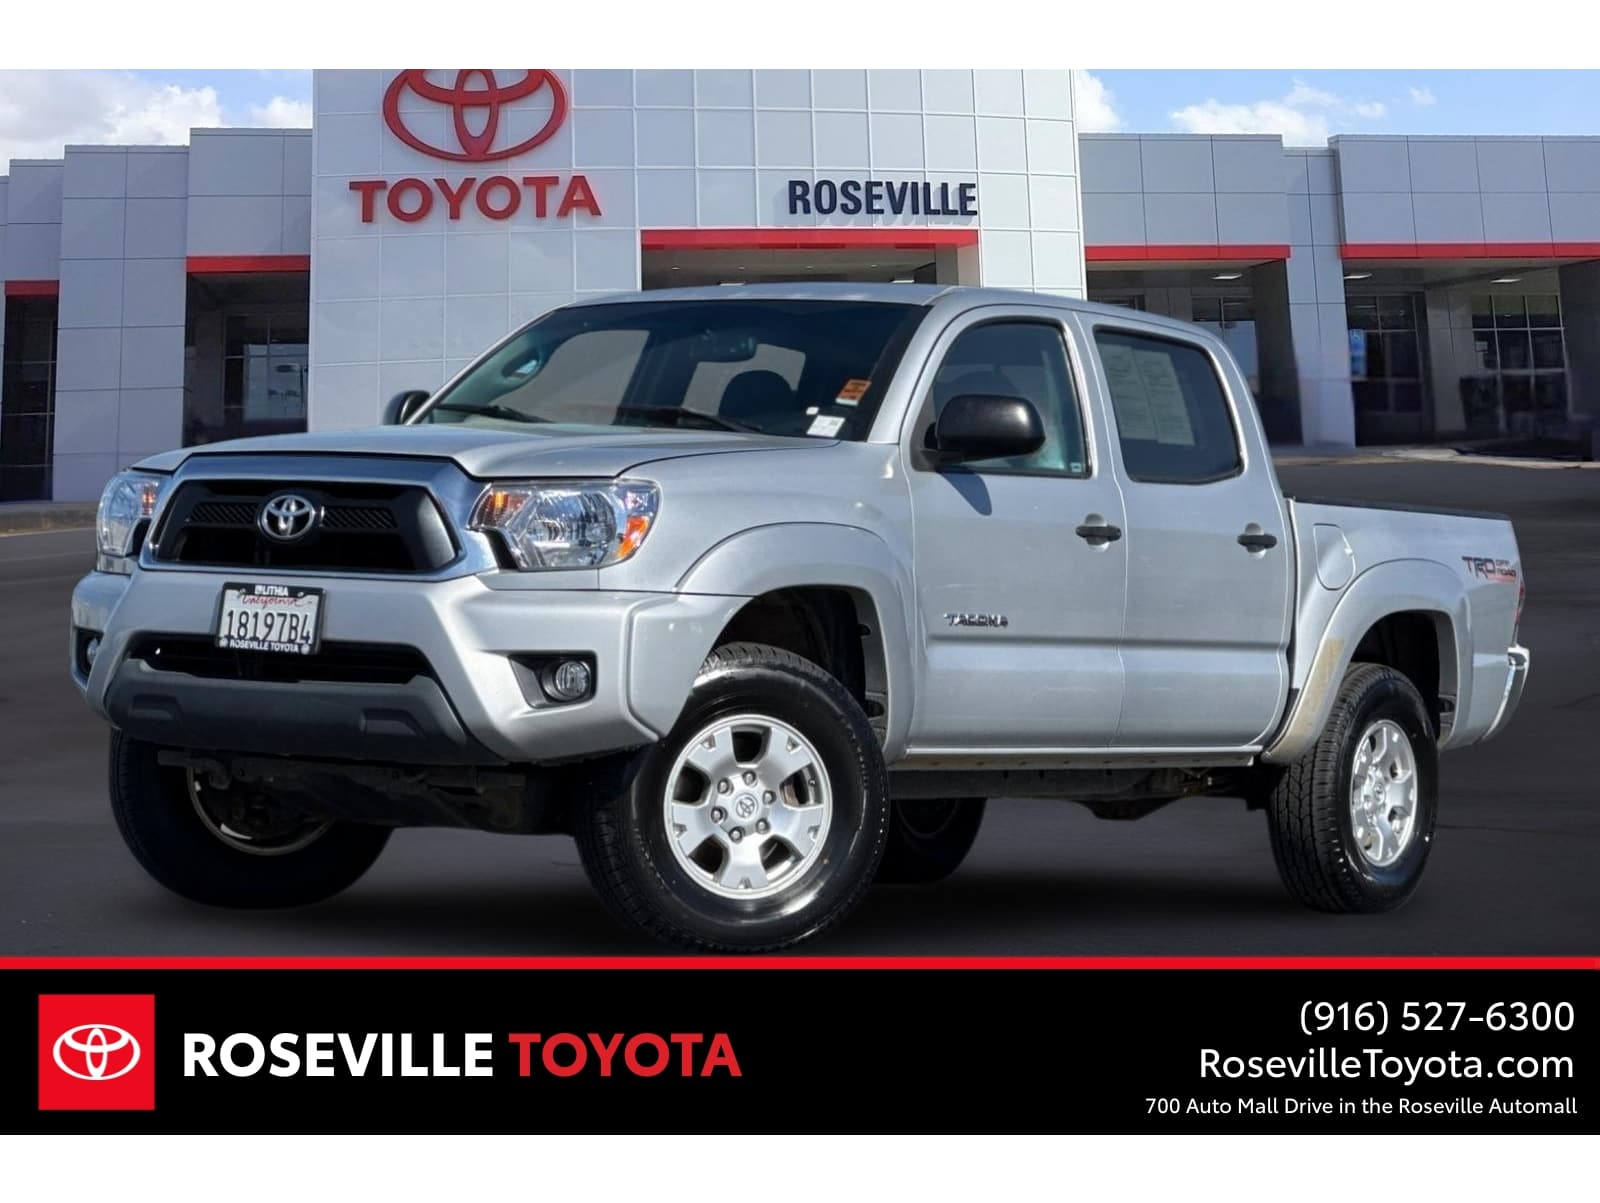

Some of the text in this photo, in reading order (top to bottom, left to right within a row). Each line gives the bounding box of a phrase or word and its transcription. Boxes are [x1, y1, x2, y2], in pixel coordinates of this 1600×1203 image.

[348, 175, 602, 223] TOYOTA
[788, 179, 978, 216] ROSEVILLE
[242, 596, 304, 609] California
[224, 609, 311, 643] 18197B4
[229, 640, 298, 652] ROSEVILLE TOYOTA
